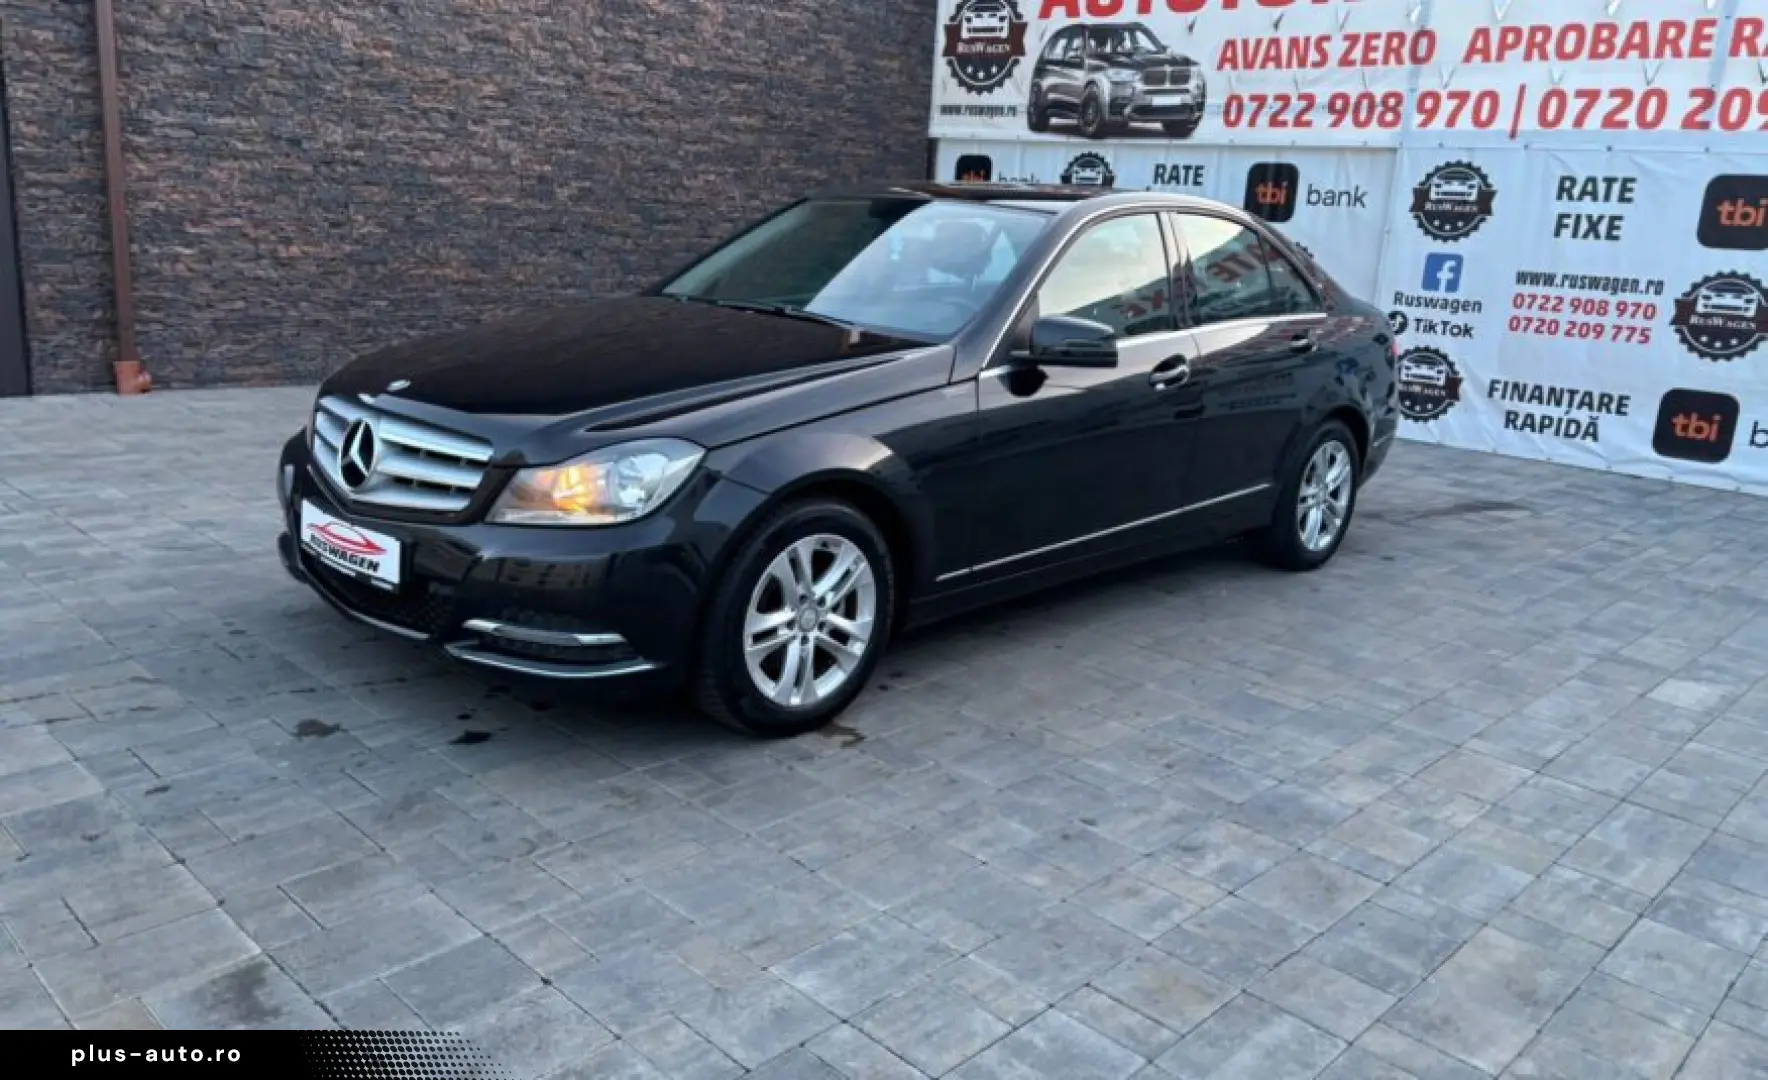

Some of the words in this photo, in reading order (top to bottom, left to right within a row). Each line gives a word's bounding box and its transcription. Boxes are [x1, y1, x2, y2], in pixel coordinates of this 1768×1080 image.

[1217, 34, 1332, 71] AVANS
[1337, 30, 1437, 67] ZERO
[1462, 18, 1717, 63] APROBARE
[1728, 17, 1768, 58] R
[1223, 92, 1316, 128] 0722
[1327, 91, 1404, 129] 908
[1416, 89, 1500, 129] 970
[1538, 88, 1668, 130] 0720
[1153, 163, 1205, 187] RATE
[1556, 175, 1637, 204] RATE
[1256, 181, 1289, 206] tbi
[1306, 184, 1369, 208] bank
[1554, 213, 1624, 241] FIXE
[1717, 198, 1768, 227] tbi
[1515, 271, 1664, 296] www.ruswagen.ro
[1393, 291, 1483, 314] Ruswagen
[1512, 292, 1564, 313] 0722
[1570, 296, 1609, 317] 908
[1616, 300, 1657, 321] 970
[1414, 317, 1474, 339] TikTok
[1508, 314, 1559, 336] 0720
[1564, 320, 1605, 340] 209
[1611, 324, 1652, 344] 775
[1487, 379, 1631, 417] FINANȚARE
[1503, 409, 1599, 442] RAPIDĂ
[1671, 412, 1722, 443] tbi
